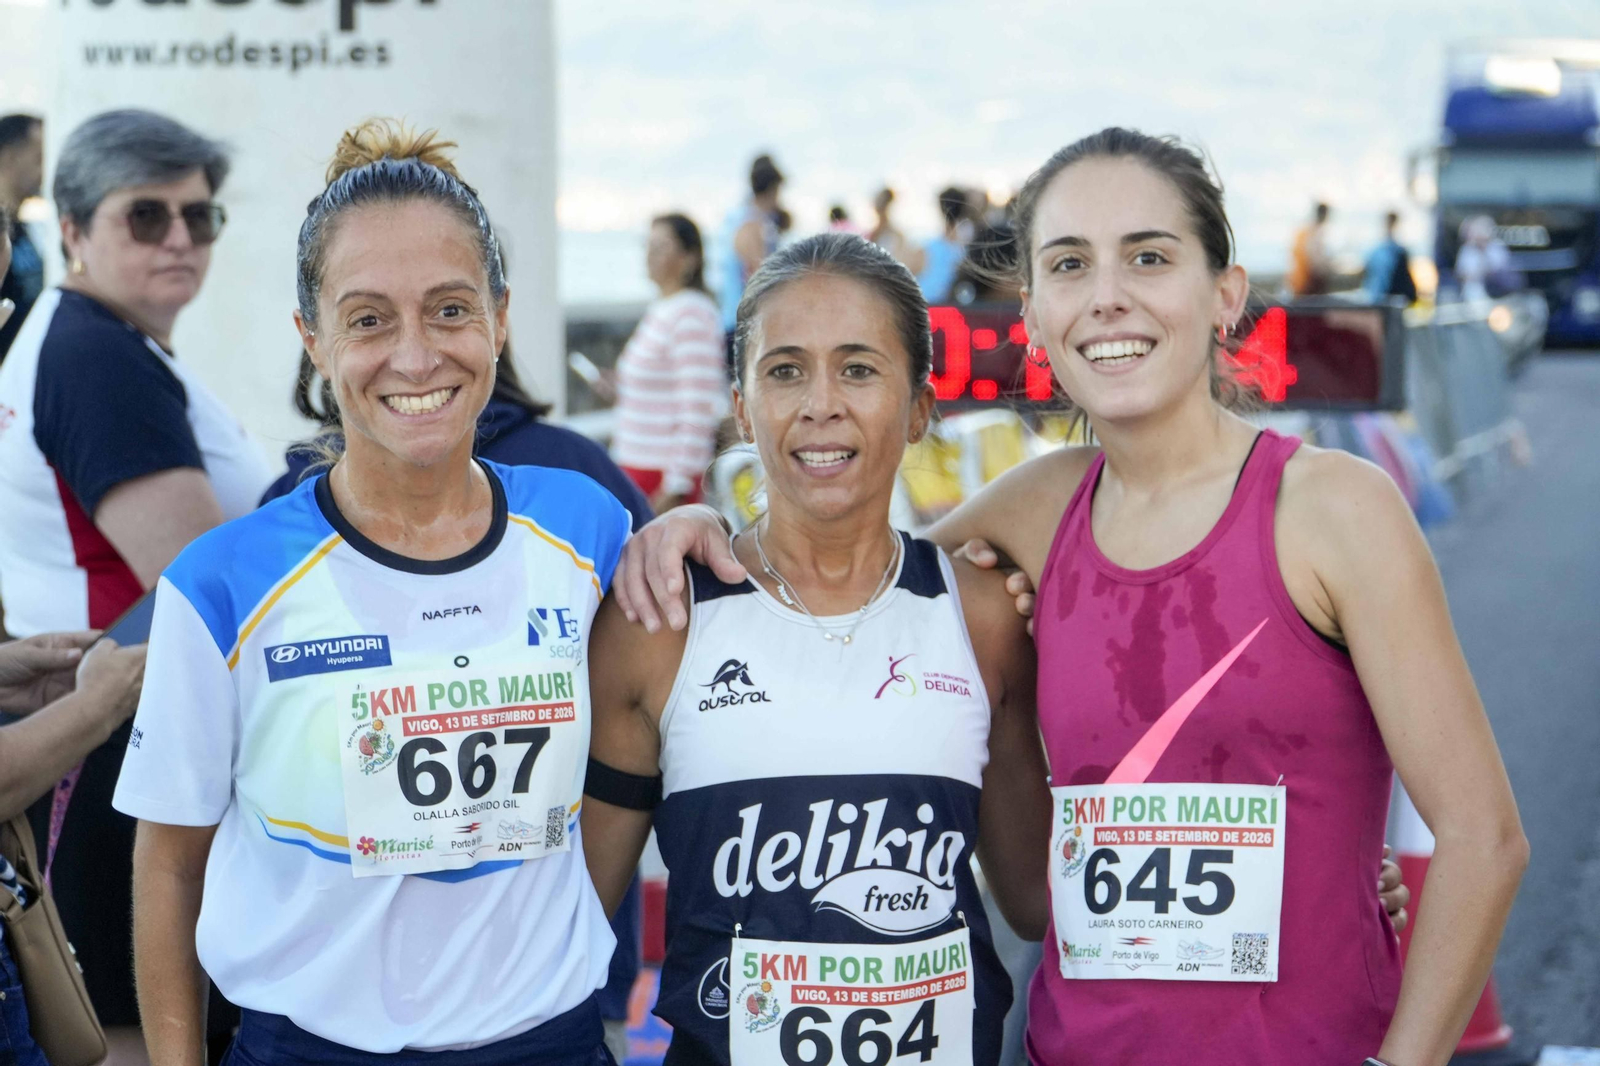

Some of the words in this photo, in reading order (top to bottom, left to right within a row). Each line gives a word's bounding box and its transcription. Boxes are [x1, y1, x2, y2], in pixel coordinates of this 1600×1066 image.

[83, 34, 391, 71] www.rodespi.es
[422, 605, 481, 620] NAFFTA
[304, 638, 382, 657] HYUNDAI
[327, 655, 363, 665] Hyupersa
[352, 685, 416, 720] 5KM
[427, 679, 490, 710] POR
[499, 671, 574, 704] MAURI
[924, 680, 971, 698] DELIKIA
[699, 691, 771, 711] austral
[407, 718, 443, 732] VIGO,
[446, 717, 459, 728] 13
[463, 716, 478, 727] DE
[481, 709, 535, 725] SETEMBRO
[538, 709, 552, 719] DE
[554, 706, 573, 719] 2026
[397, 726, 550, 806] 667
[413, 808, 459, 821] OLALLA
[462, 801, 500, 817] SABORIDO
[503, 799, 520, 809] GIL
[1063, 796, 1105, 824] 5KM
[1112, 796, 1167, 822] POR
[1177, 796, 1278, 824] MAURI
[374, 835, 434, 854] Marisé
[451, 840, 471, 849] Porto
[498, 842, 523, 852] ADN
[713, 798, 965, 897] delikia
[1096, 831, 1120, 844] VIGO,
[1123, 831, 1135, 842] 13
[1138, 831, 1152, 842] DE
[1155, 831, 1218, 843] SETEMBRO
[1222, 831, 1239, 843] DE
[1242, 832, 1272, 844] 2026
[1084, 847, 1235, 916] 645
[863, 885, 929, 912] fresh
[1088, 920, 1115, 929] LAURA
[1118, 919, 1146, 929] SOTO
[1148, 920, 1203, 929] CARNEIRO
[743, 952, 806, 981] 5KM
[819, 956, 883, 984] POR
[894, 941, 967, 982] MAURI
[1112, 951, 1131, 960] Porto
[1133, 951, 1142, 960] de
[1143, 951, 1160, 962] Vigo
[1176, 963, 1200, 972] ADN
[796, 989, 830, 1003] VIGO,
[834, 990, 848, 1002] 13
[852, 991, 868, 1002] DE
[871, 985, 928, 1003] SETEMBRO
[930, 982, 942, 993] DE
[945, 976, 965, 989] 2026
[780, 998, 939, 1066] 664
